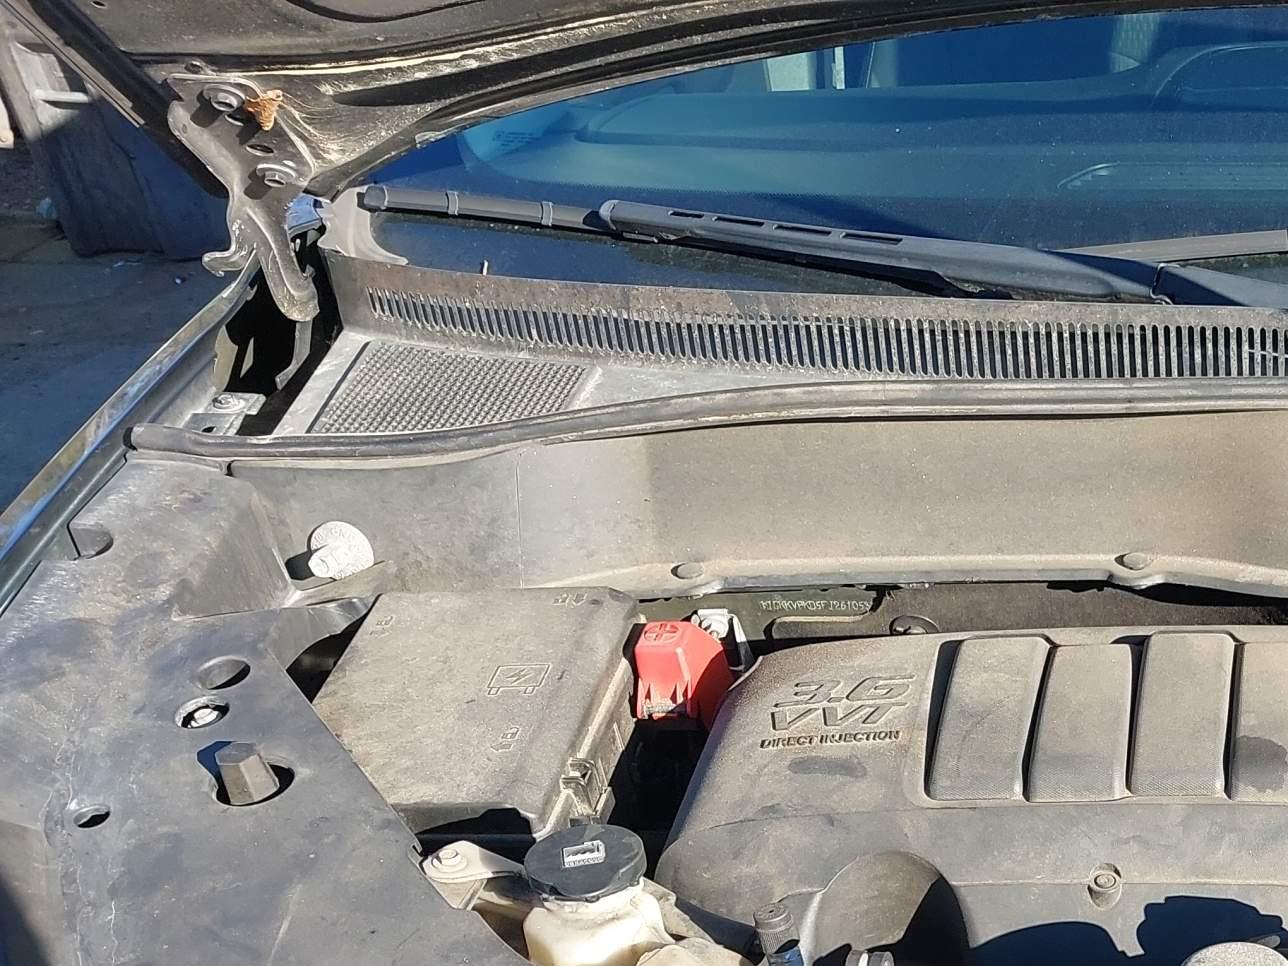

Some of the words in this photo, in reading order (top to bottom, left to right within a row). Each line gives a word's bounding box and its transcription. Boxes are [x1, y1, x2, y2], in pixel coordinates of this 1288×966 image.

[774, 674, 918, 709] 3.6
[770, 702, 910, 732] VVT
[759, 735, 815, 750] DIRECT
[819, 730, 900, 745] INJECTION
